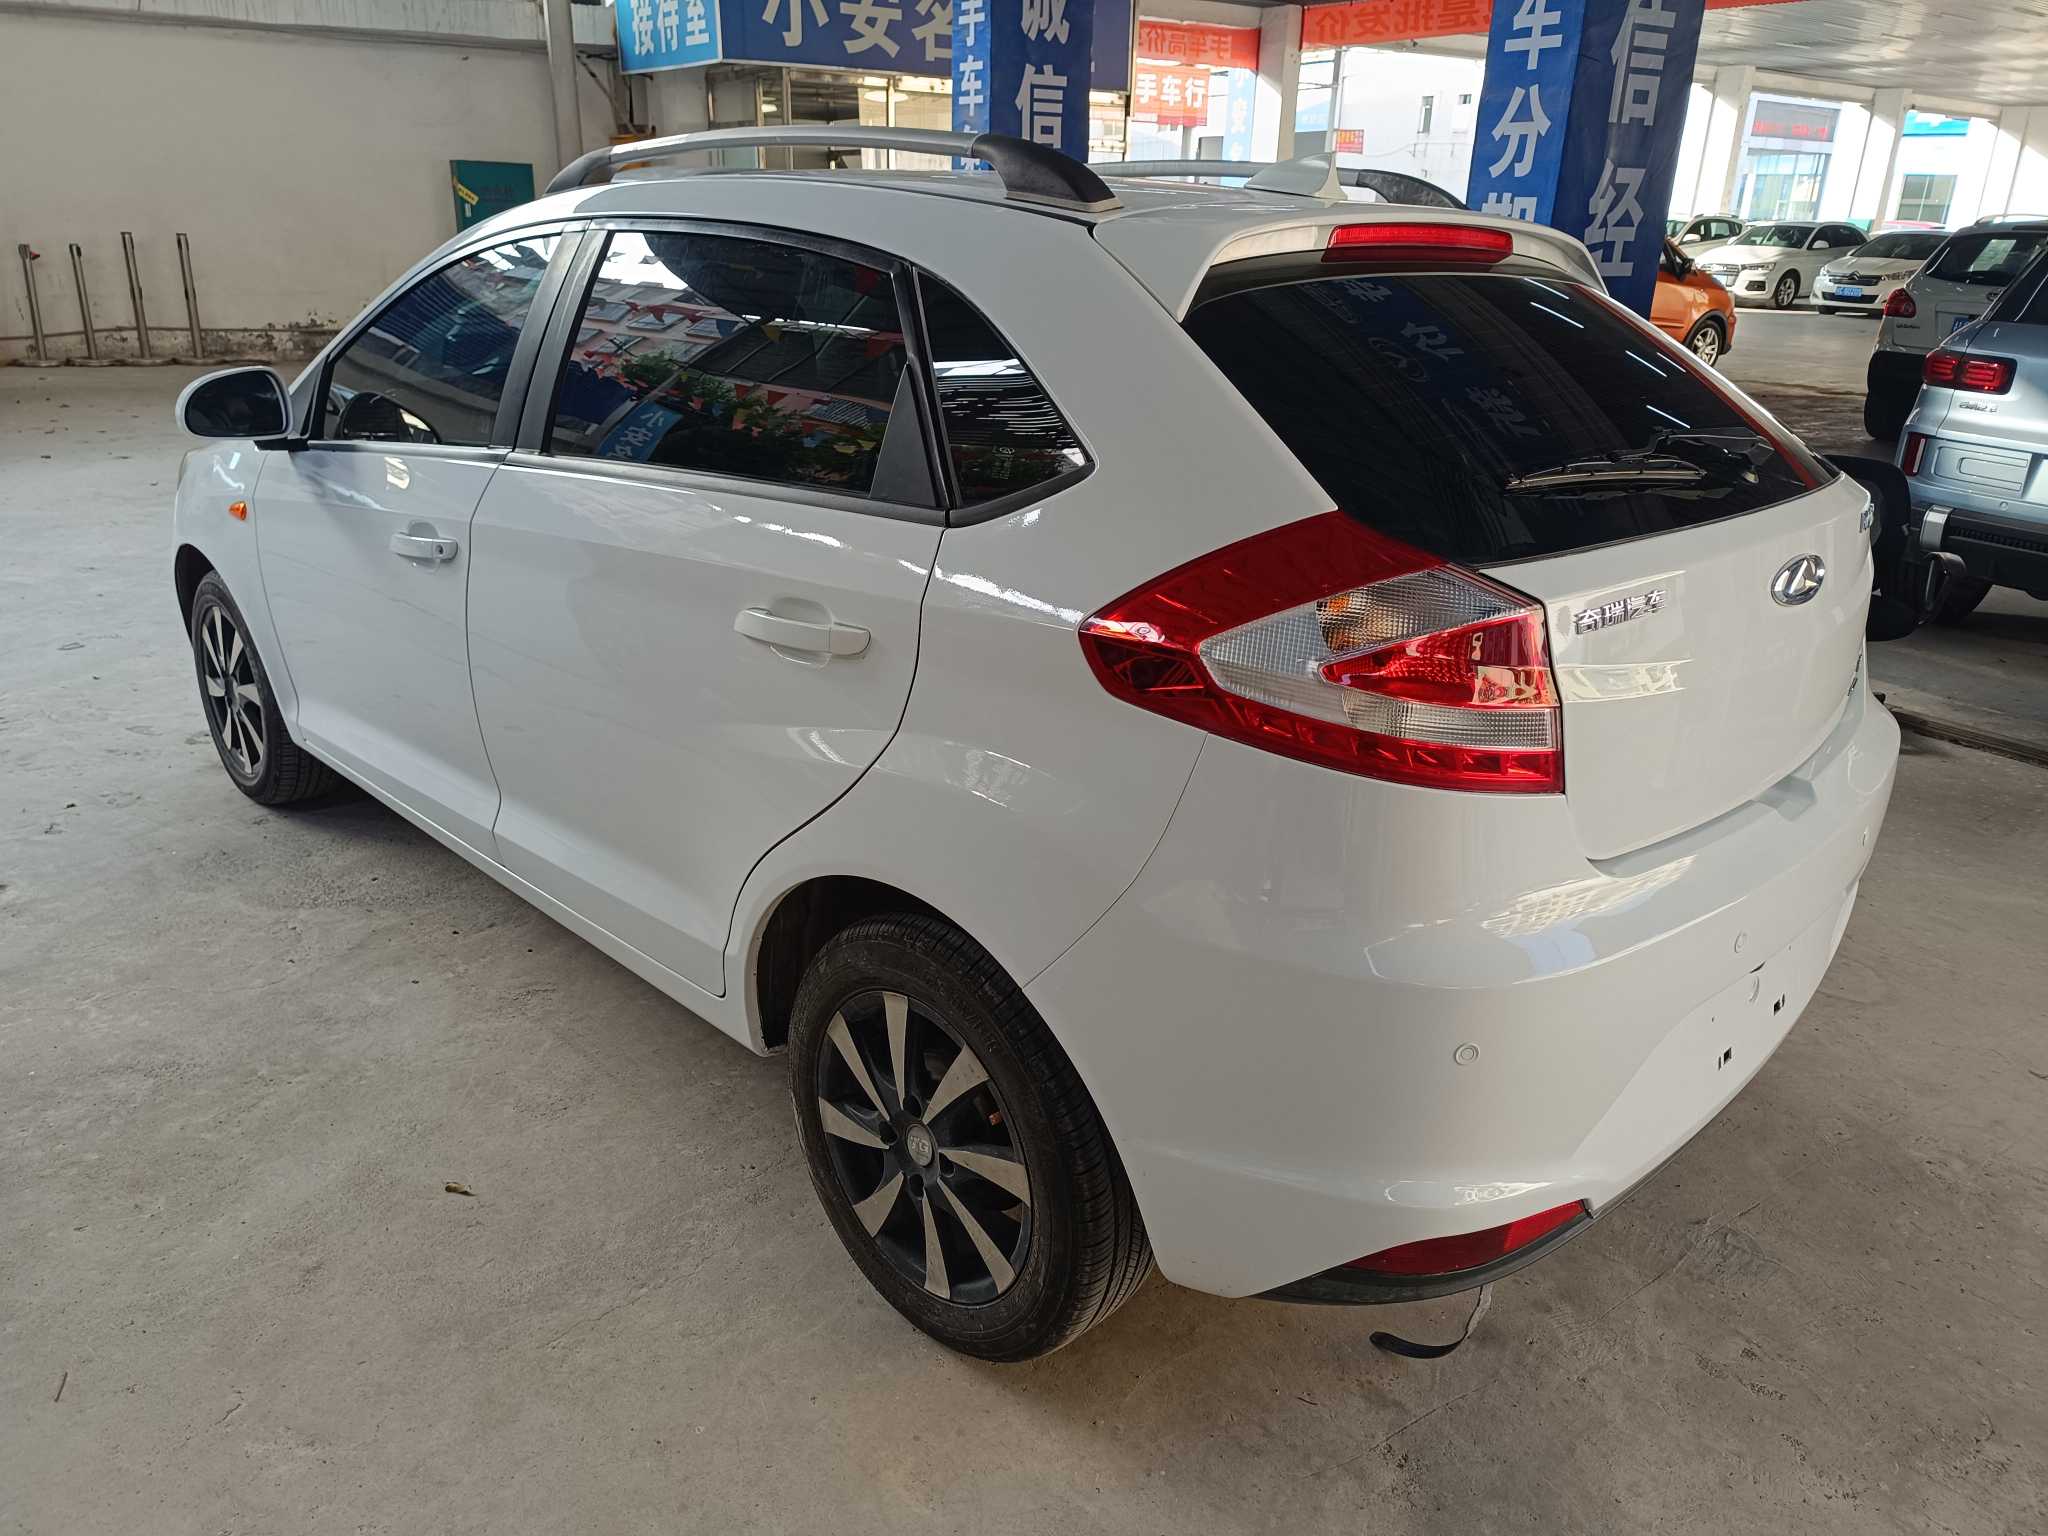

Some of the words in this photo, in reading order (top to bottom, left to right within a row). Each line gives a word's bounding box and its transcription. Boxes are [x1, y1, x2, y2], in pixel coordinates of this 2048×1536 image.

[957, 0, 985, 170] 手车
[1135, 73, 1207, 108] 手车行
[1584, 0, 1677, 278] 信经
[1574, 589, 1667, 635] 奇瑞汽车
